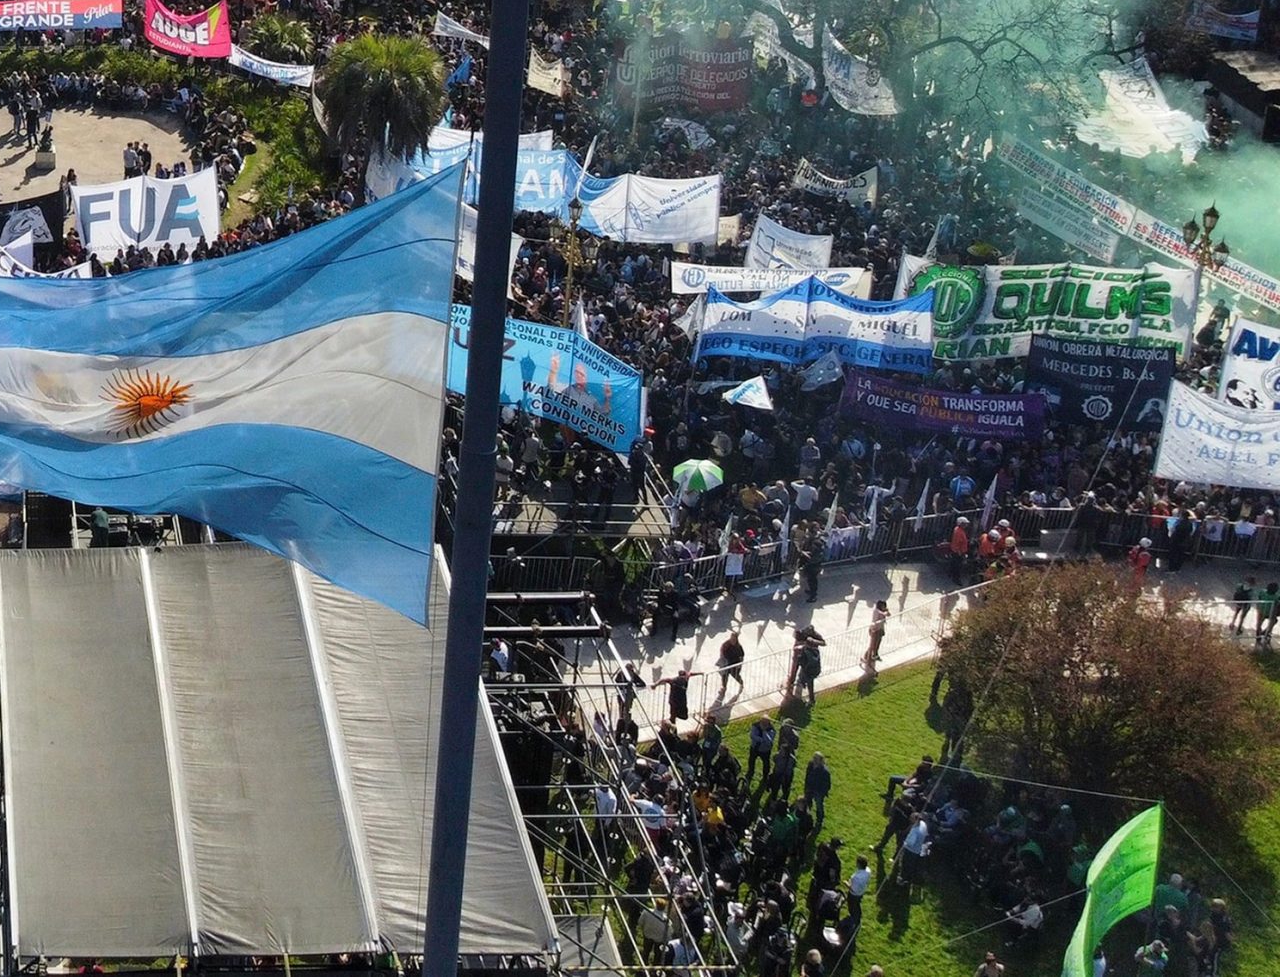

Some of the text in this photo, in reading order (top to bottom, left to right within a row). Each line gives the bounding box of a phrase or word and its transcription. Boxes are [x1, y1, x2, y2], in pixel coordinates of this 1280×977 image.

[0, 14, 74, 27] GRANDE
[3, 1, 70, 14] FRENTE
[83, 2, 113, 23] Pilar
[151, 10, 210, 45] AUGE
[659, 179, 708, 206] Universidad
[79, 183, 206, 246] FUA
[858, 322, 920, 337] MIGUEL
[513, 332, 610, 378] LOMAS DE ZAMORA
[550, 331, 640, 378] DE LA UNIVERSIDAD
[1034, 336, 1169, 361] UNION OBRERA METALURGICA
[1042, 357, 1113, 379] MERCEDES
[522, 381, 626, 435] WALTER MERKIS
[856, 379, 1025, 412] LA EDUCACIÓN TRANSFORMA
[856, 392, 864, 402] Y
[866, 393, 890, 409] QUE
[893, 399, 916, 415] SEA
[977, 413, 1024, 427] IGUALA
[531, 398, 616, 446] CONDUCCION
